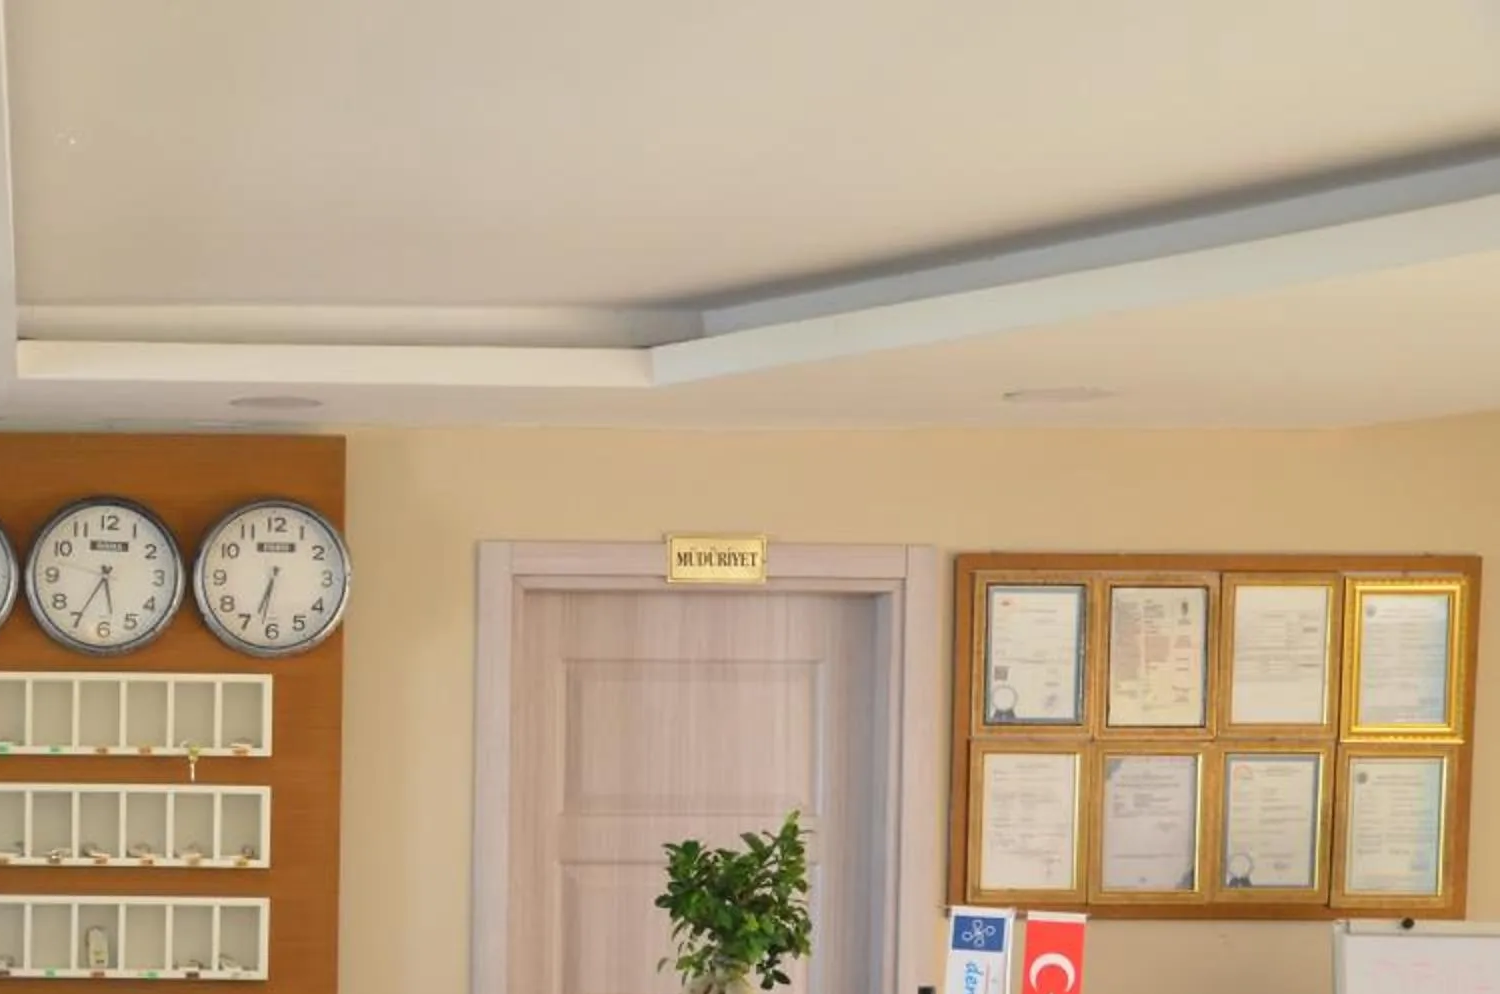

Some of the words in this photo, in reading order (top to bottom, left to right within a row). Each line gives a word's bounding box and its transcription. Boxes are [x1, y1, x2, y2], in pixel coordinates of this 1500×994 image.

[73, 522, 88, 537] 11
[101, 515, 120, 531] 12
[267, 517, 287, 533] 12
[132, 524, 137, 538] 1
[240, 524, 255, 539] 11
[300, 526, 304, 540] 1
[54, 541, 72, 556] 10
[145, 544, 157, 559] 2
[221, 544, 239, 559] 10
[312, 545, 325, 560] 2
[45, 567, 59, 582] 9
[153, 569, 165, 586] 3
[213, 569, 226, 585] 9
[321, 571, 333, 587] 3
[52, 593, 67, 609] 8
[143, 597, 156, 612] 4
[220, 596, 234, 612] 8
[311, 598, 324, 613] 4
[71, 612, 83, 627] 7
[125, 614, 138, 629] 5
[239, 614, 251, 630] 7
[293, 615, 306, 631] 5
[97, 622, 111, 637] 6
[265, 623, 279, 639] 6
